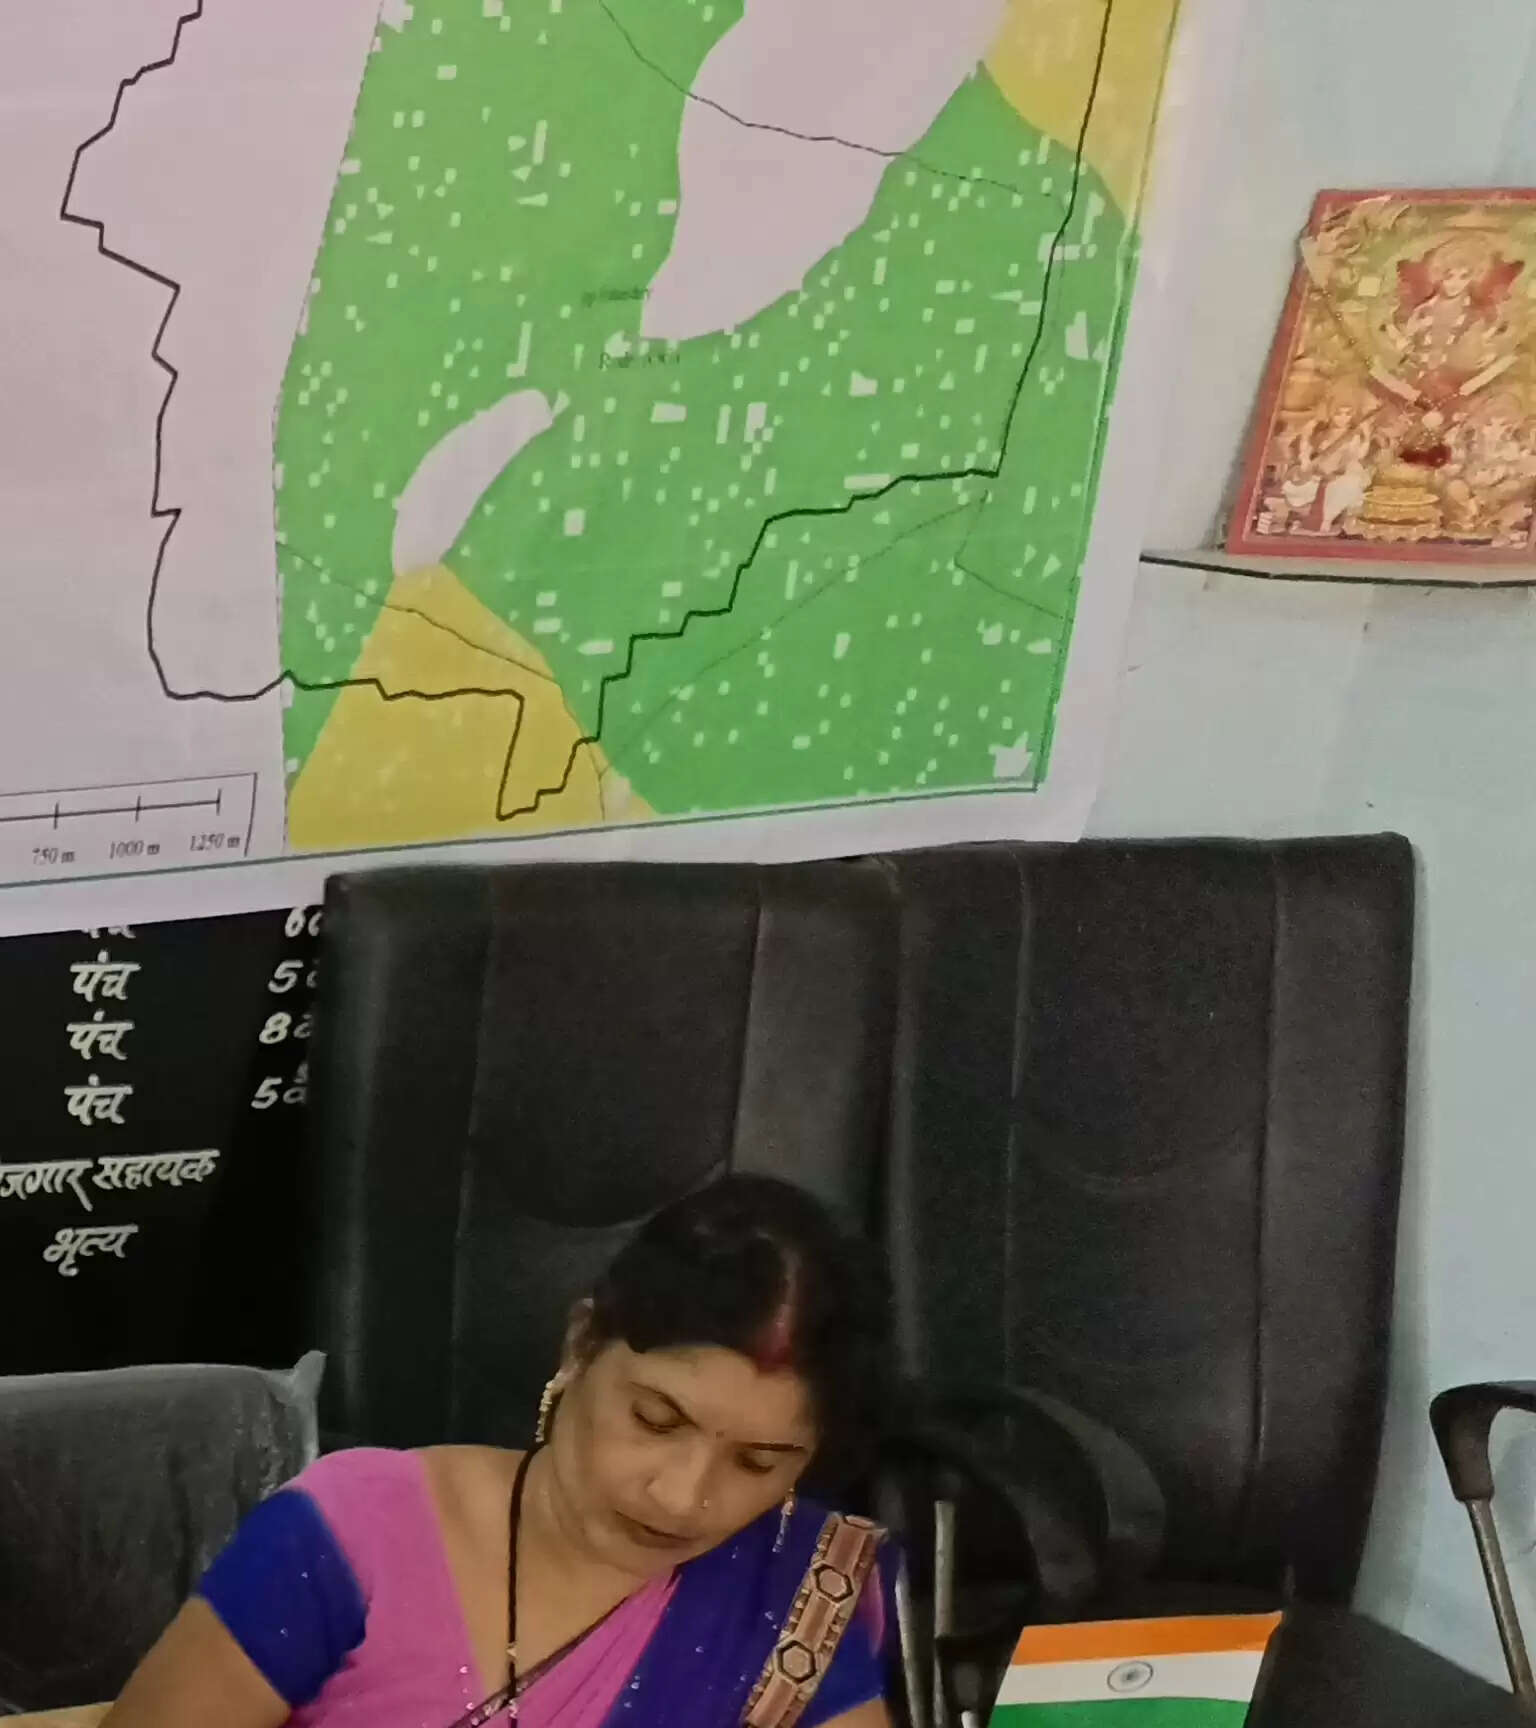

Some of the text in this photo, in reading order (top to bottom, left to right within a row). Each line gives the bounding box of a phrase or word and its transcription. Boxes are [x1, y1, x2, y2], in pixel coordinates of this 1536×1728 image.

[71, 949, 141, 1002] पंच
[66, 1009, 135, 1060] पंच
[64, 1073, 133, 1126] पंच
[93, 1149, 221, 1190] सहायक
[43, 1223, 138, 1277] भृत्य
